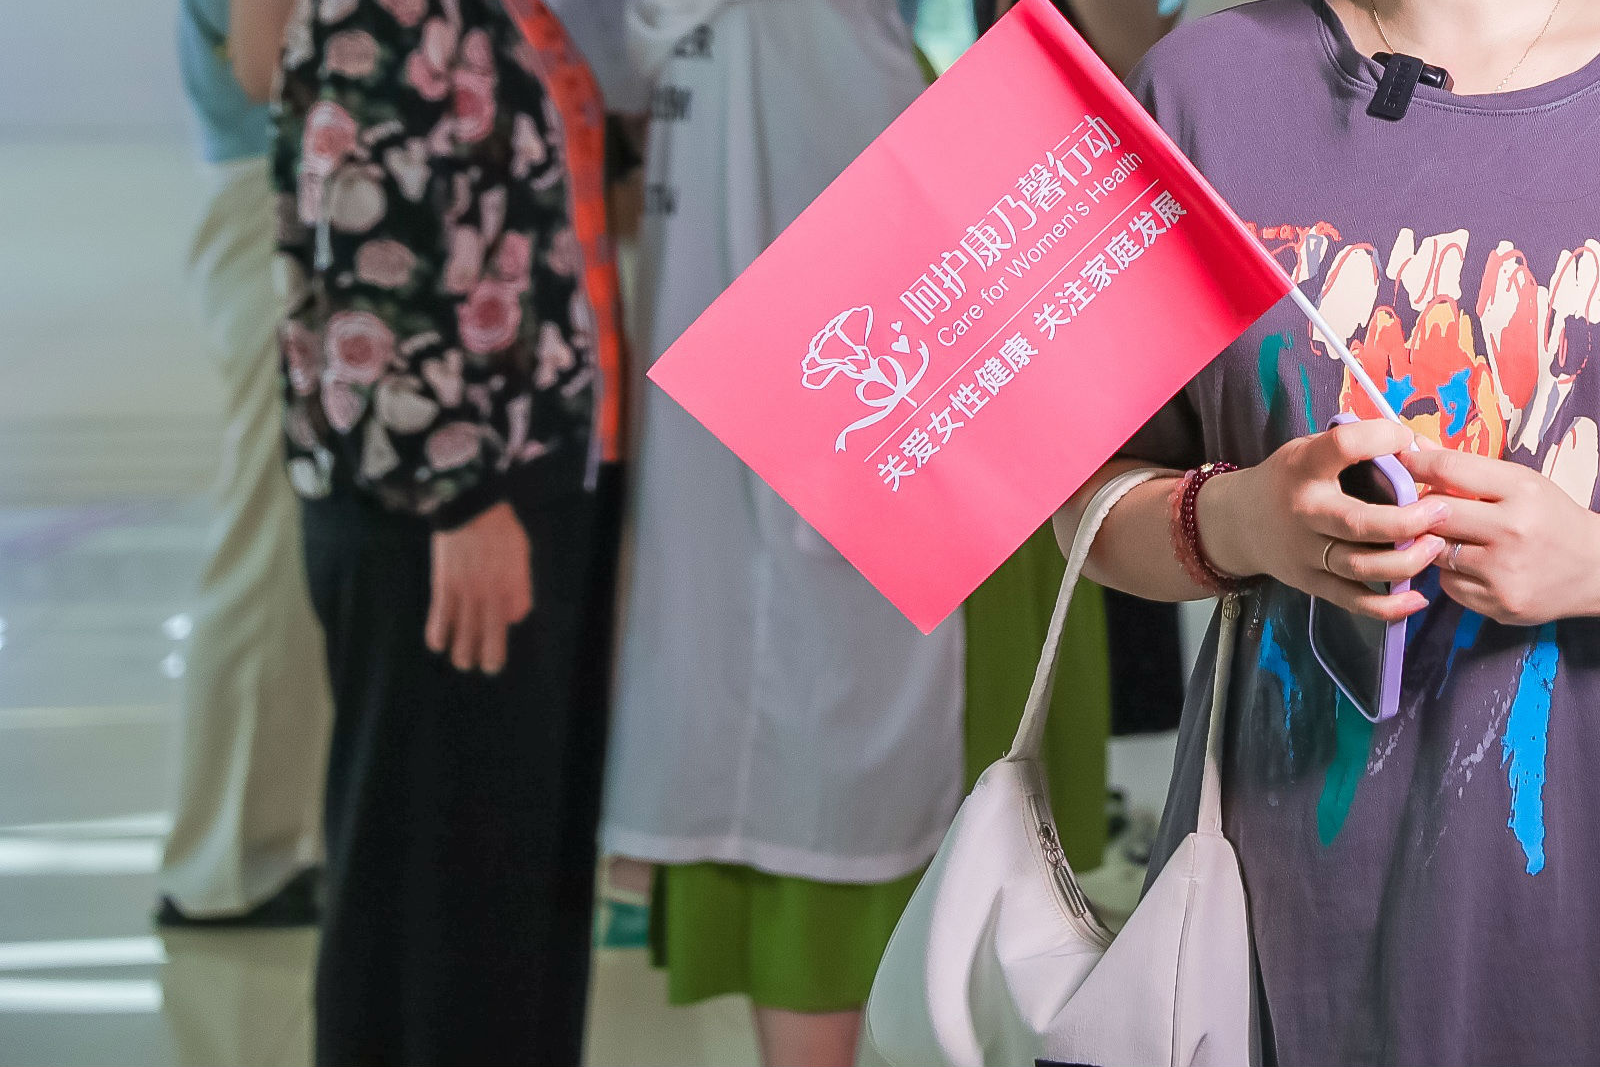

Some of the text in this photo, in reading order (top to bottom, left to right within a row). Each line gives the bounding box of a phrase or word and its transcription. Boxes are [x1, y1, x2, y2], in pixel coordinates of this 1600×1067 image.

[899, 114, 1122, 326] 呵护康乃馨行动
[937, 151, 1144, 347] Care for Women's Health
[877, 189, 1188, 493] 关爱女性健康 关注家庭发展
